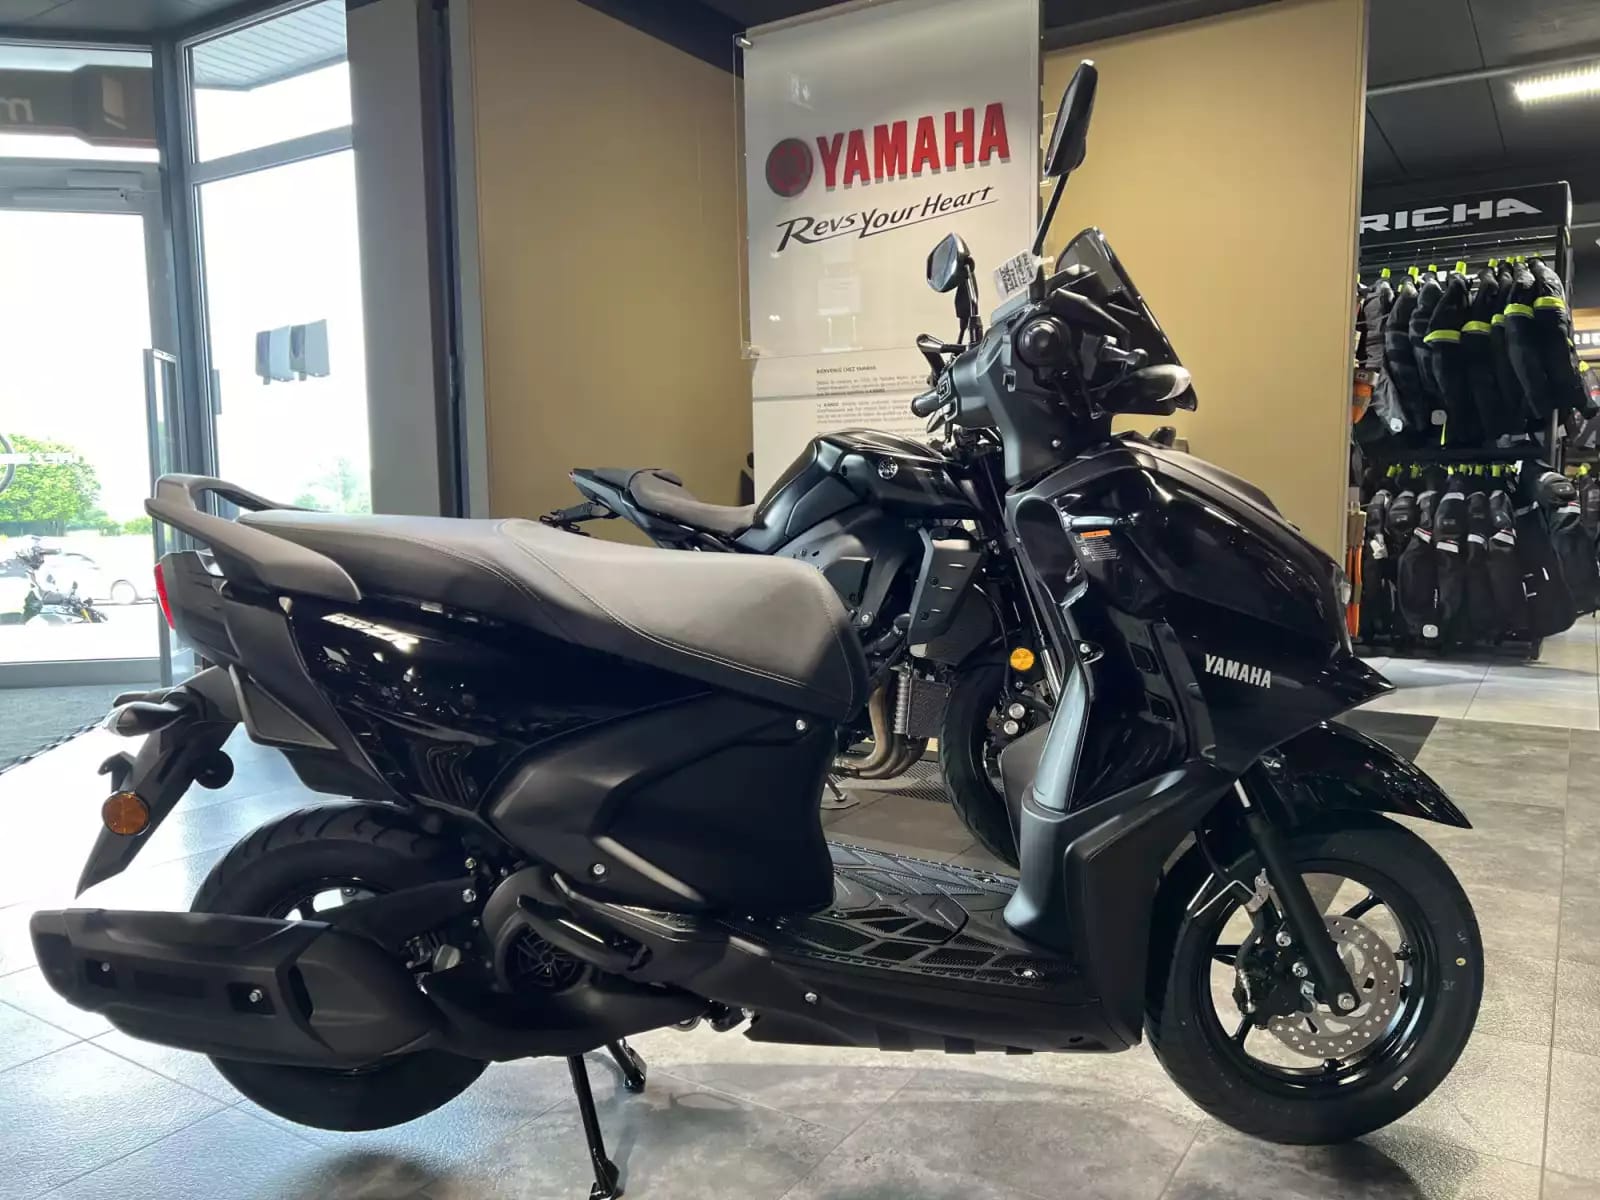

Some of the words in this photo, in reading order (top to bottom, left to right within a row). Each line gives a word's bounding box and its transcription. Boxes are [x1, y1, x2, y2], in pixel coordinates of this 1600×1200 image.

[816, 102, 1011, 190] YAMAHA
[776, 212, 858, 252] Revs
[858, 203, 921, 239] Your
[920, 186, 995, 218] Heart
[1360, 198, 1542, 234] RICHA
[1205, 653, 1271, 689] YAMAHA
